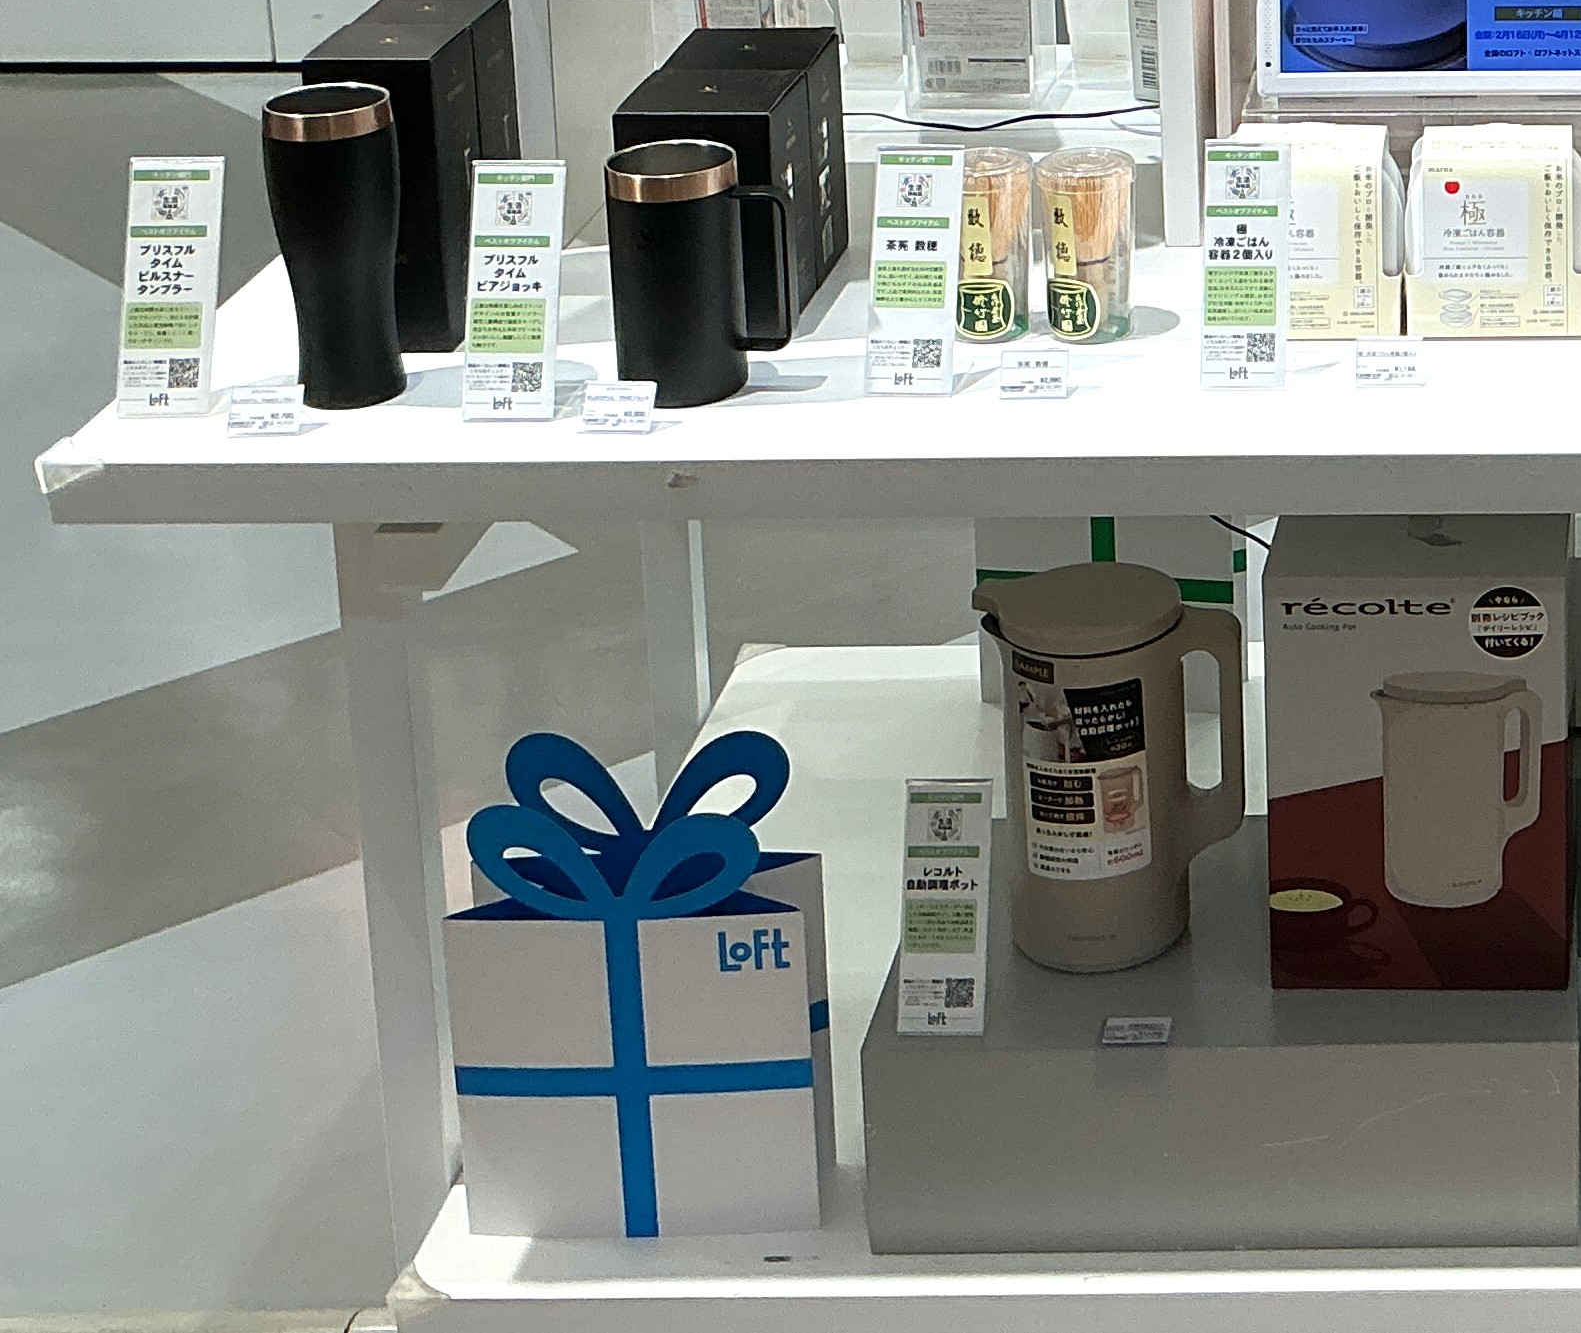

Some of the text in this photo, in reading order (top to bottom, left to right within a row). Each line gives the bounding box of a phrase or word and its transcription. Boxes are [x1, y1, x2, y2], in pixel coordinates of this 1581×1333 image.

[1459, 199, 1487, 226] 極
[1213, 235, 1270, 249] 冷凍ごはん
[149, 257, 183, 269] タイム
[493, 267, 527, 279] タイム
[136, 283, 194, 295] タンブラー
[476, 280, 543, 293] ビアジョッキ
[893, 372, 914, 386] Loft
[1228, 366, 1250, 380] Loft
[149, 392, 170, 407] Loft
[492, 396, 513, 410] Loft
[1280, 596, 1453, 617] récolte
[1282, 621, 1304, 632] Auto
[922, 865, 964, 878] レコルト
[906, 878, 979, 892] 自動調理ポット
[717, 927, 791, 972] Loft
[927, 1011, 948, 1026] Loft
